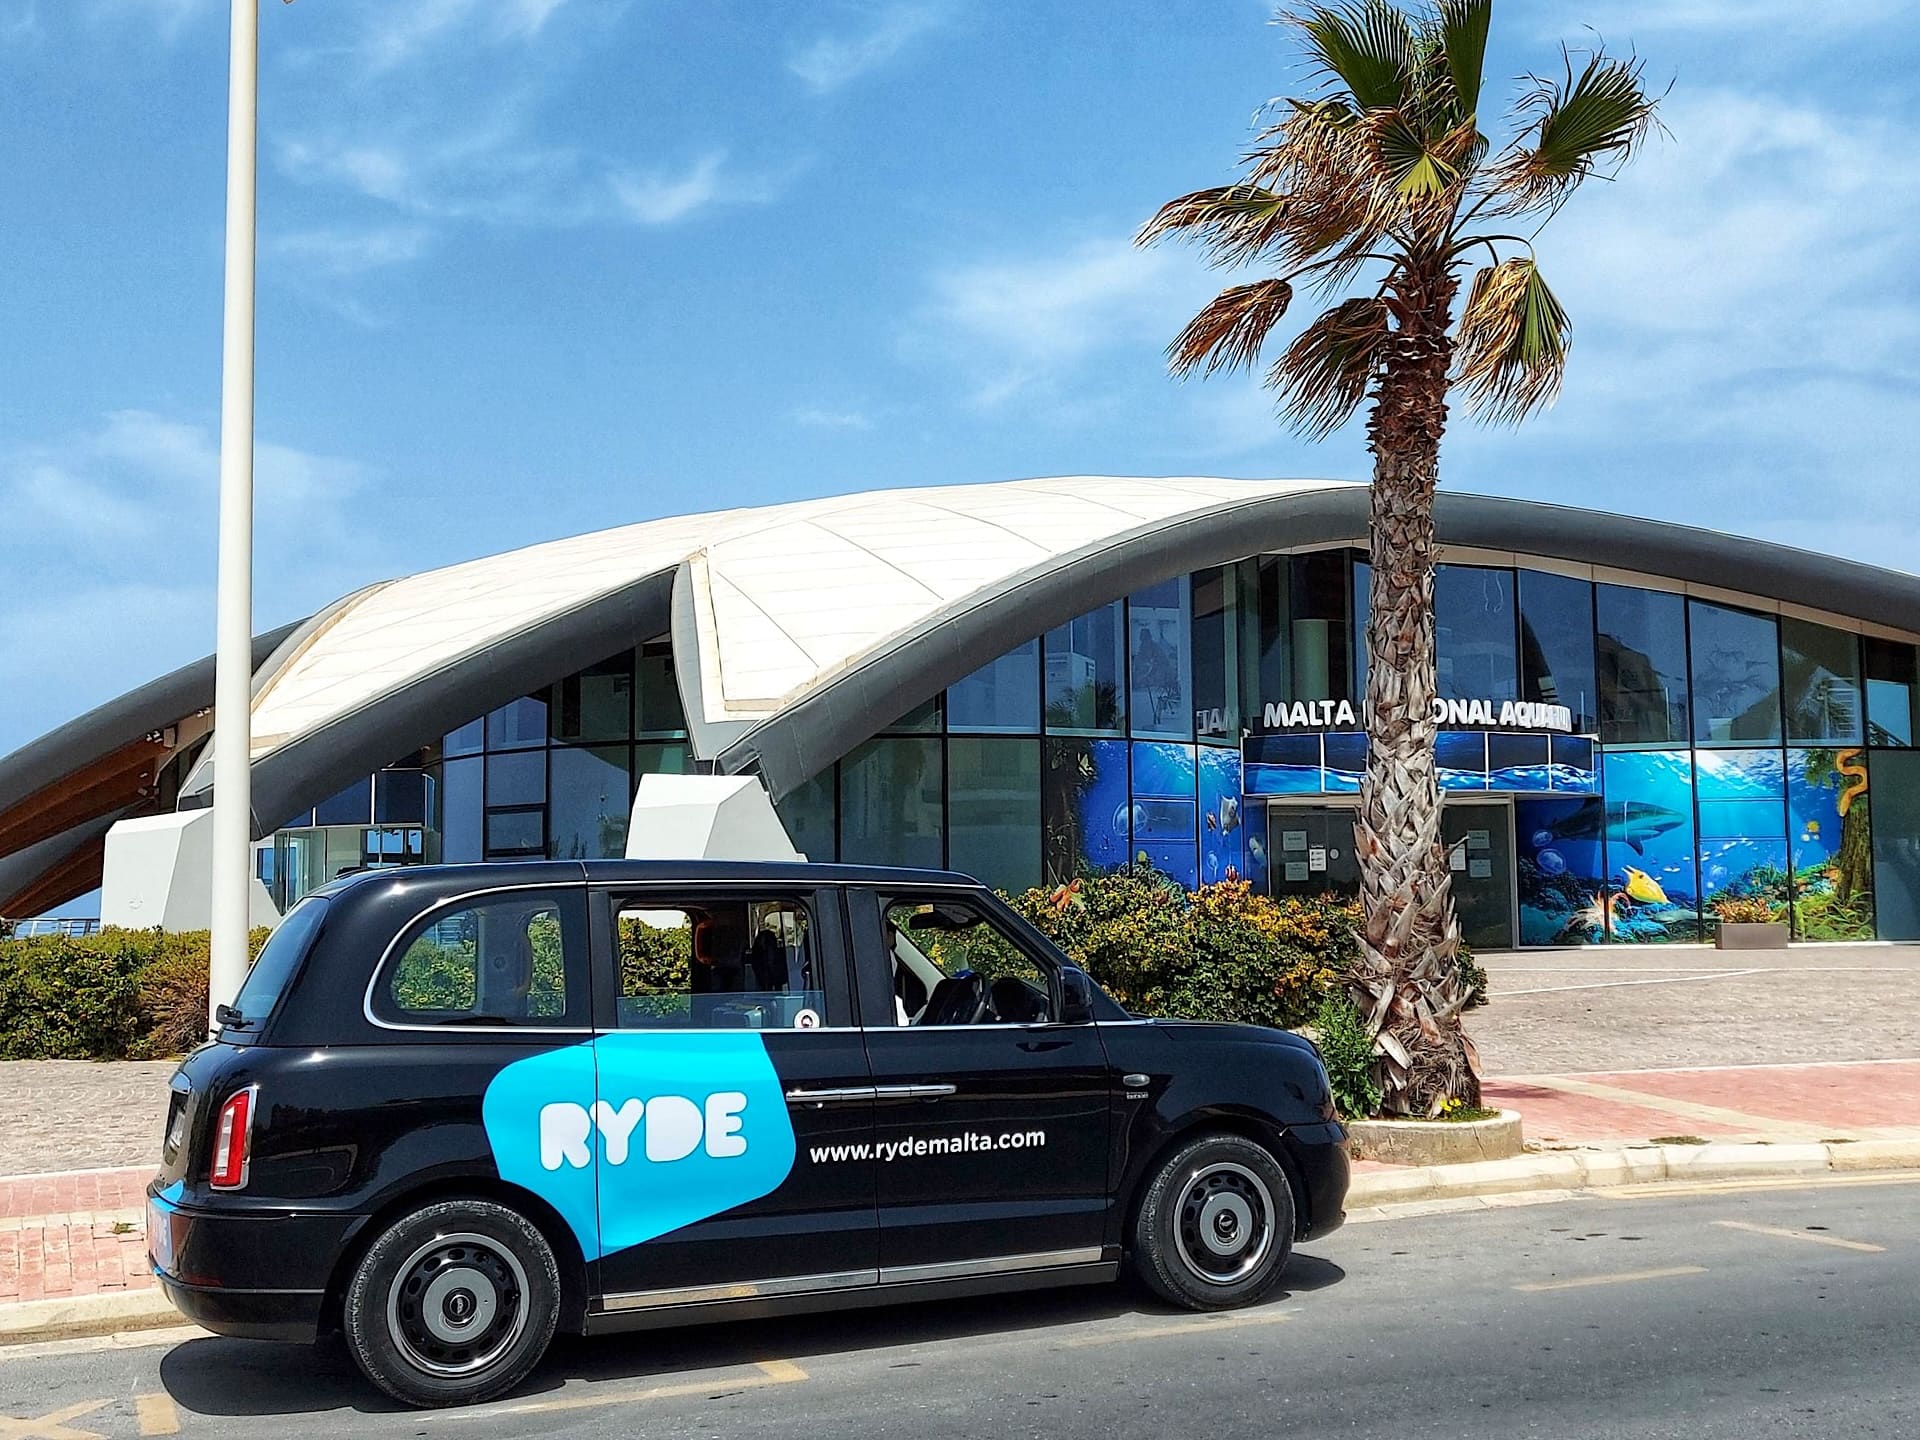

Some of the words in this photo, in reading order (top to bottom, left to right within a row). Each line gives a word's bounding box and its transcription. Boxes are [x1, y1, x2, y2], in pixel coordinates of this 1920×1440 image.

[1263, 699, 1356, 728] MALTA
[1499, 700, 1573, 733] AQUAR
[539, 1091, 748, 1171] RYDE
[809, 1130, 1046, 1163] www.rydemalta.com
